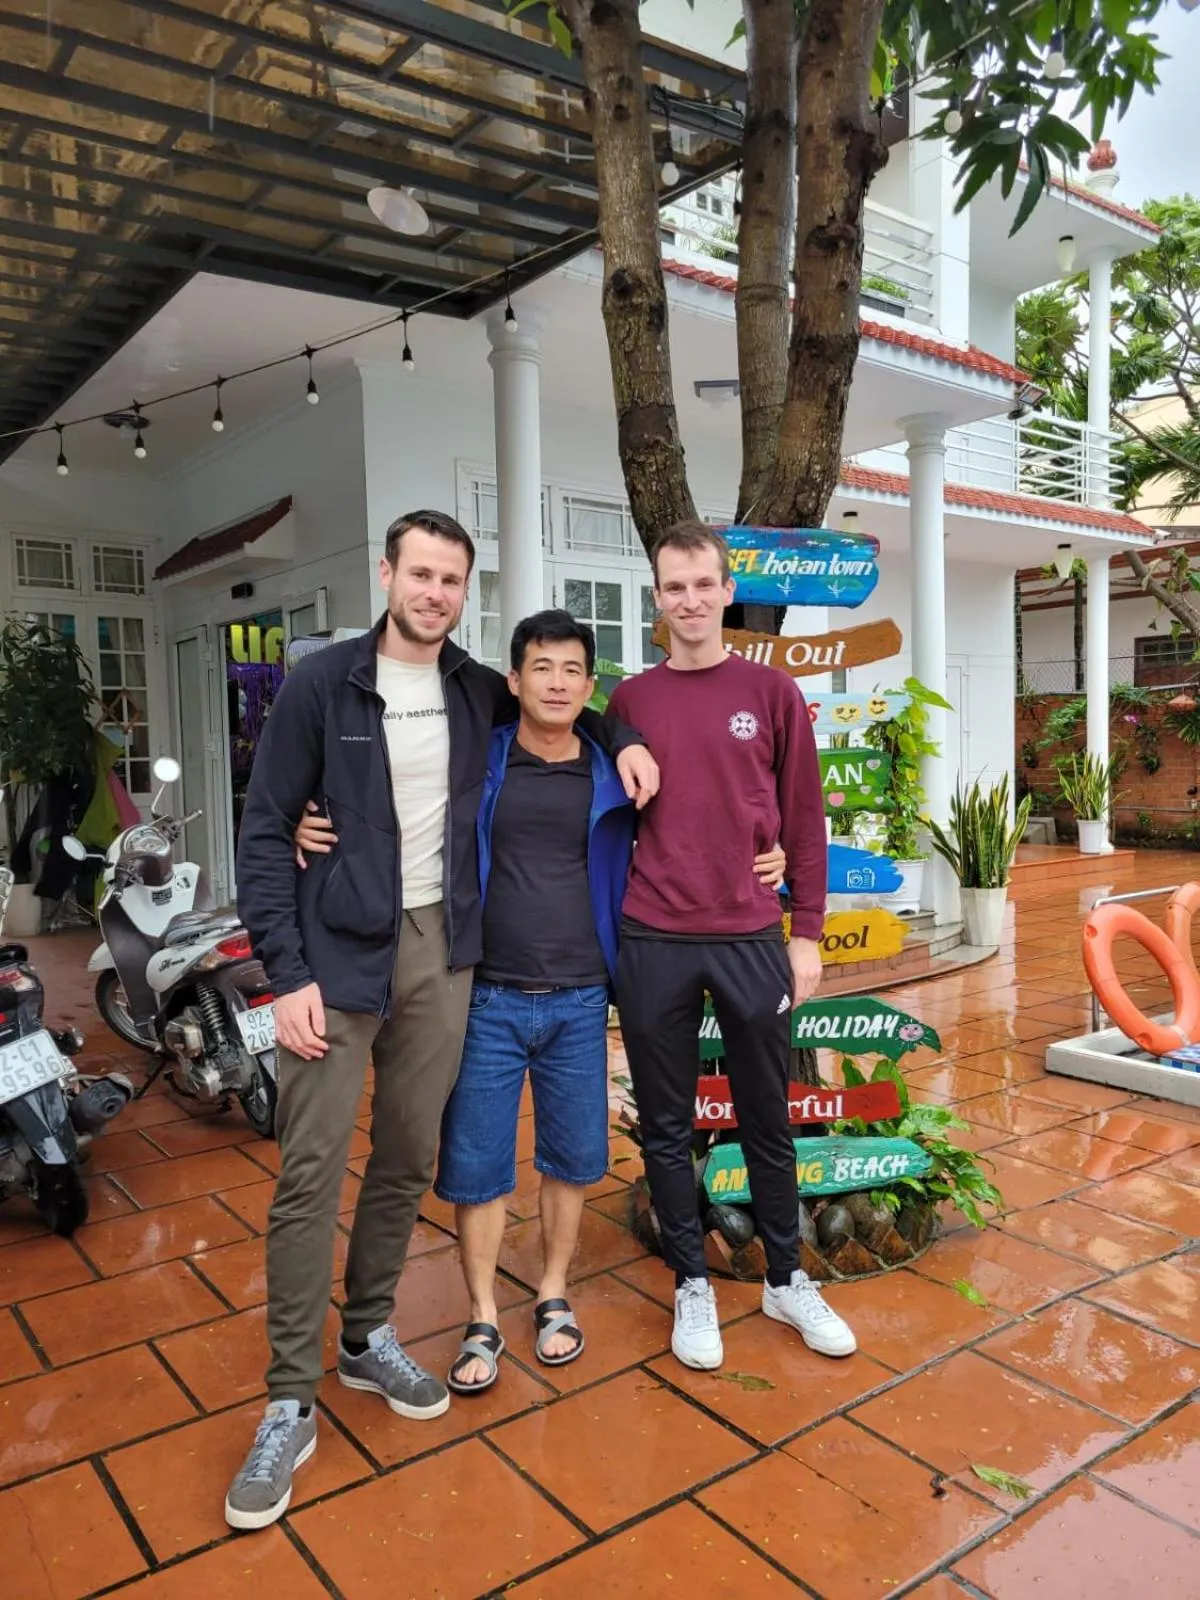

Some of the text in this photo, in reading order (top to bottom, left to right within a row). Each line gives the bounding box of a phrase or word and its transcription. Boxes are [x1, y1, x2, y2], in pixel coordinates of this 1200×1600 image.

[828, 553, 873, 576] town
[786, 641, 846, 666] Out
[823, 763, 863, 786] AN
[818, 925, 870, 952] ool
[797, 1014, 900, 1039] HOLIDAY
[835, 1155, 909, 1182] BEACH
